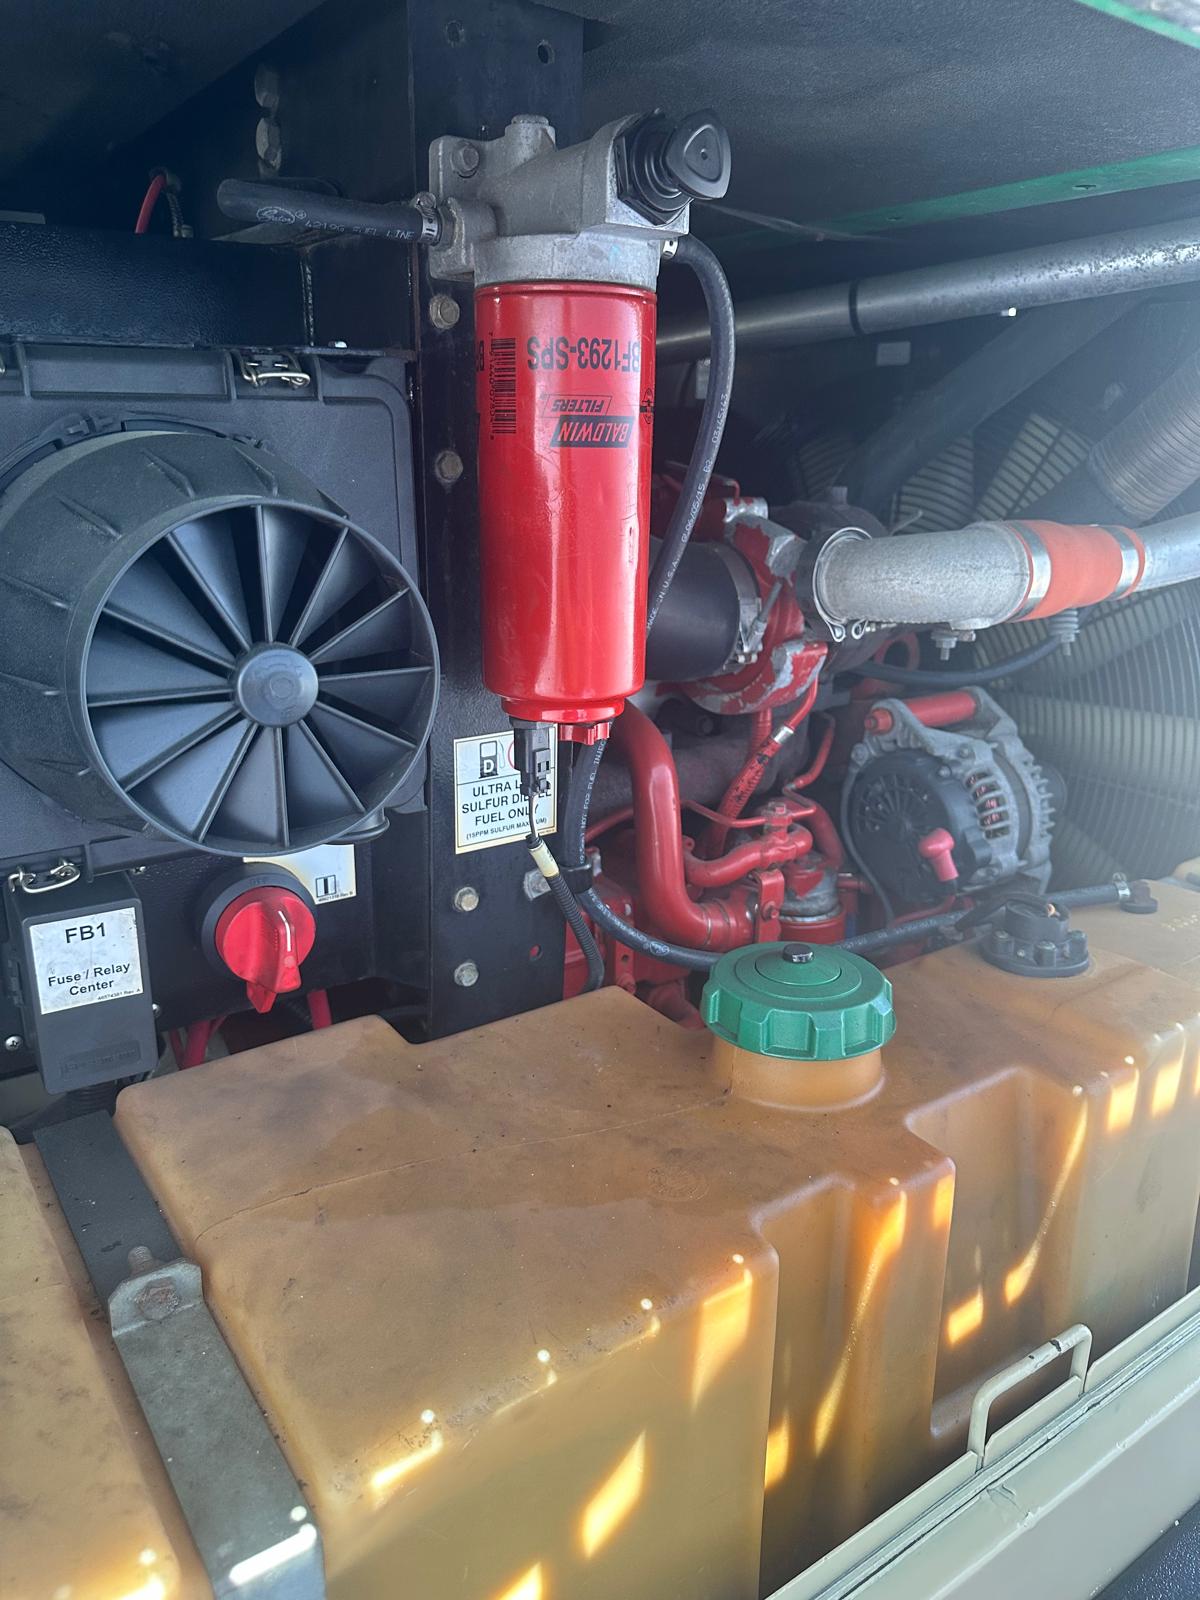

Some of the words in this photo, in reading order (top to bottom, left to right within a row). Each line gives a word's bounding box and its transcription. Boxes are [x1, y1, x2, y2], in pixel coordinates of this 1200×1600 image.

[527, 336, 641, 373] BF1293-SPS
[551, 398, 605, 413] FILTERS
[557, 420, 630, 443] BALDWIN
[472, 781, 512, 797] ULTRA
[461, 795, 509, 814] SULFUR
[466, 829, 489, 840] (15PPM
[490, 824, 515, 834] SULFUR
[516, 817, 547, 829] MAXUM)
[475, 811, 505, 826] FUEL
[65, 922, 106, 944] FB1
[48, 973, 81, 987] Fuse
[93, 963, 131, 978] Relay
[69, 979, 115, 996] Center
